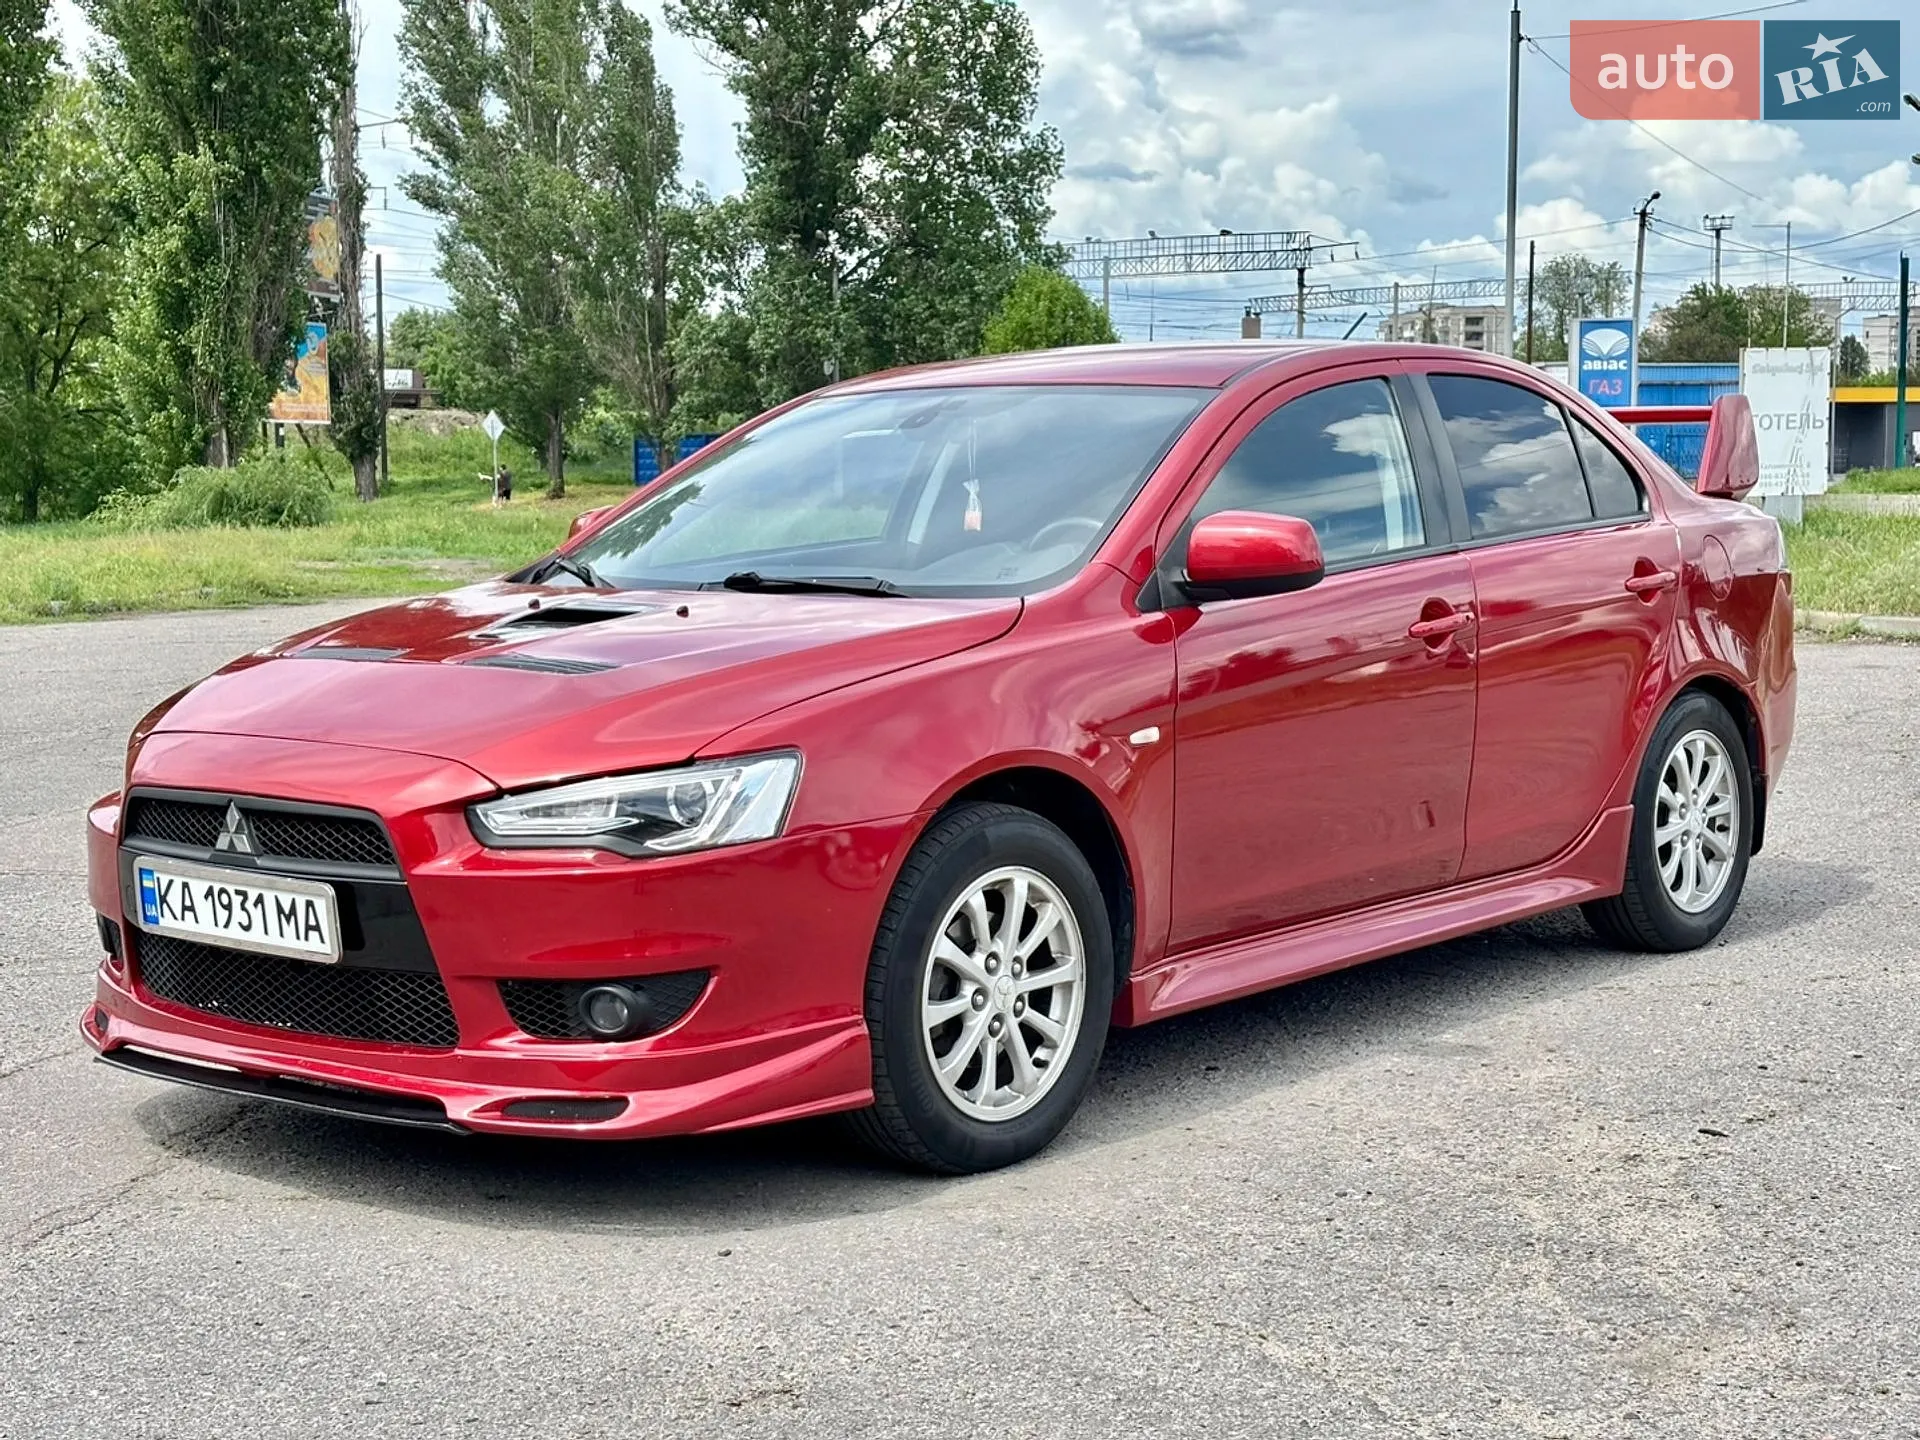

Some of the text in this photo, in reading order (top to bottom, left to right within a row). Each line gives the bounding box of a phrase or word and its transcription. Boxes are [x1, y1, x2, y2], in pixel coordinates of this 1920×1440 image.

[1588, 378, 1623, 396] ГАЗ
[145, 903, 158, 918] UA
[157, 875, 326, 945] KA 1931 MA
